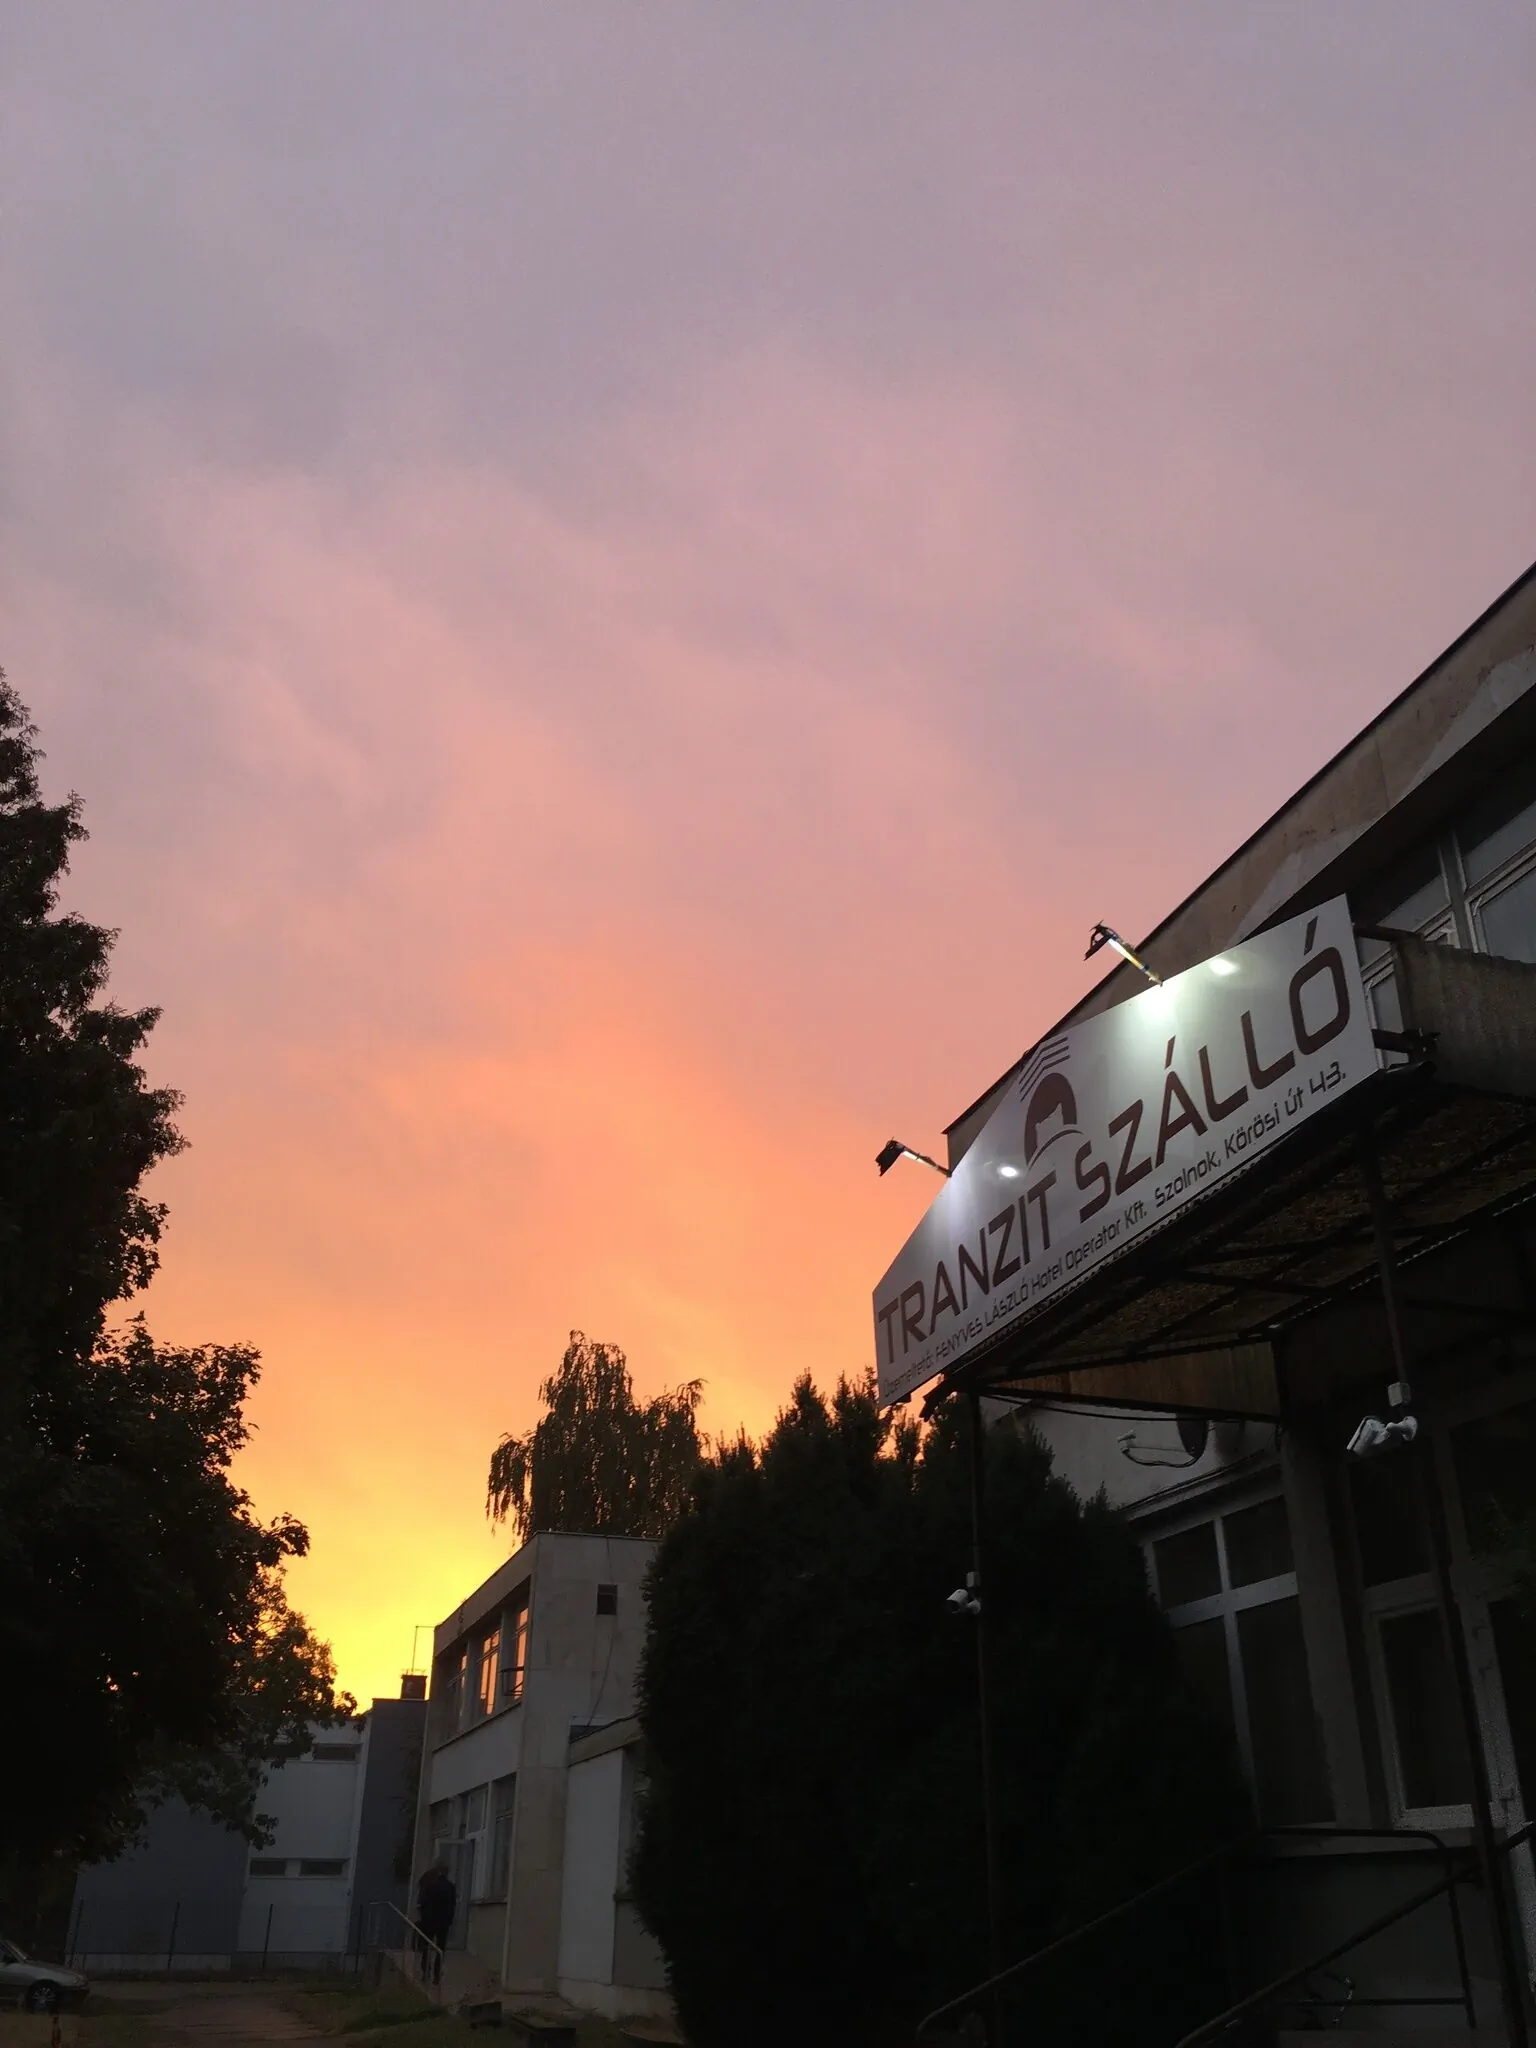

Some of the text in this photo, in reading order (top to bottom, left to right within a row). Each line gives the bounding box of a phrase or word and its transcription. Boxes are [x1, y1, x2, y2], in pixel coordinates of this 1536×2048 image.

[879, 916, 1351, 1364] TRANZIT SZÁLLÓ
[935, 1318, 983, 1358] FENYVES
[984, 1278, 1029, 1328] LÁSZLÓ
[1031, 1257, 1063, 1296] Hotel
[1065, 1218, 1121, 1270] Operator
[1124, 1200, 1148, 1229] Kft.
[1155, 1151, 1222, 1208] Szolnok,
[1284, 1087, 1304, 1117] út
[1309, 1061, 1347, 1095] 43.
